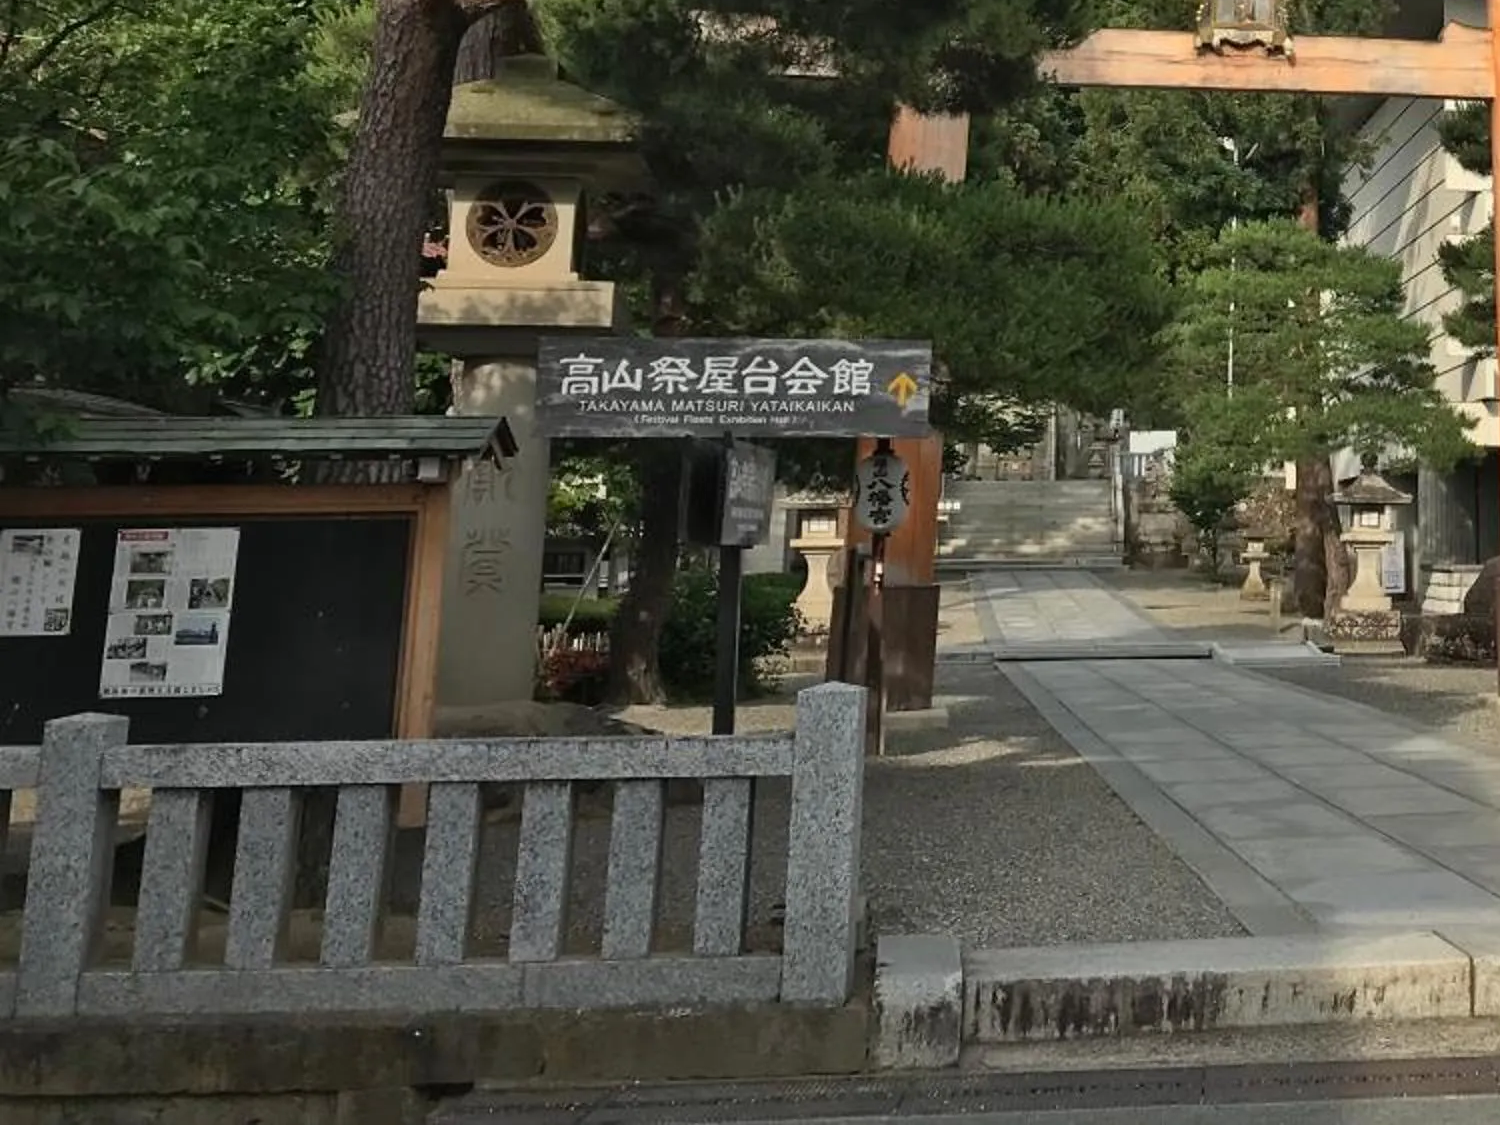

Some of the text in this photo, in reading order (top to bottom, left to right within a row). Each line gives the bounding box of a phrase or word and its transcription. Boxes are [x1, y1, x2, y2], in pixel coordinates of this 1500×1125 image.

[559, 352, 874, 396] 高山祭屋台会館
[579, 399, 855, 412] TAKAYAMA MATSURI YATAIKAIKAN
